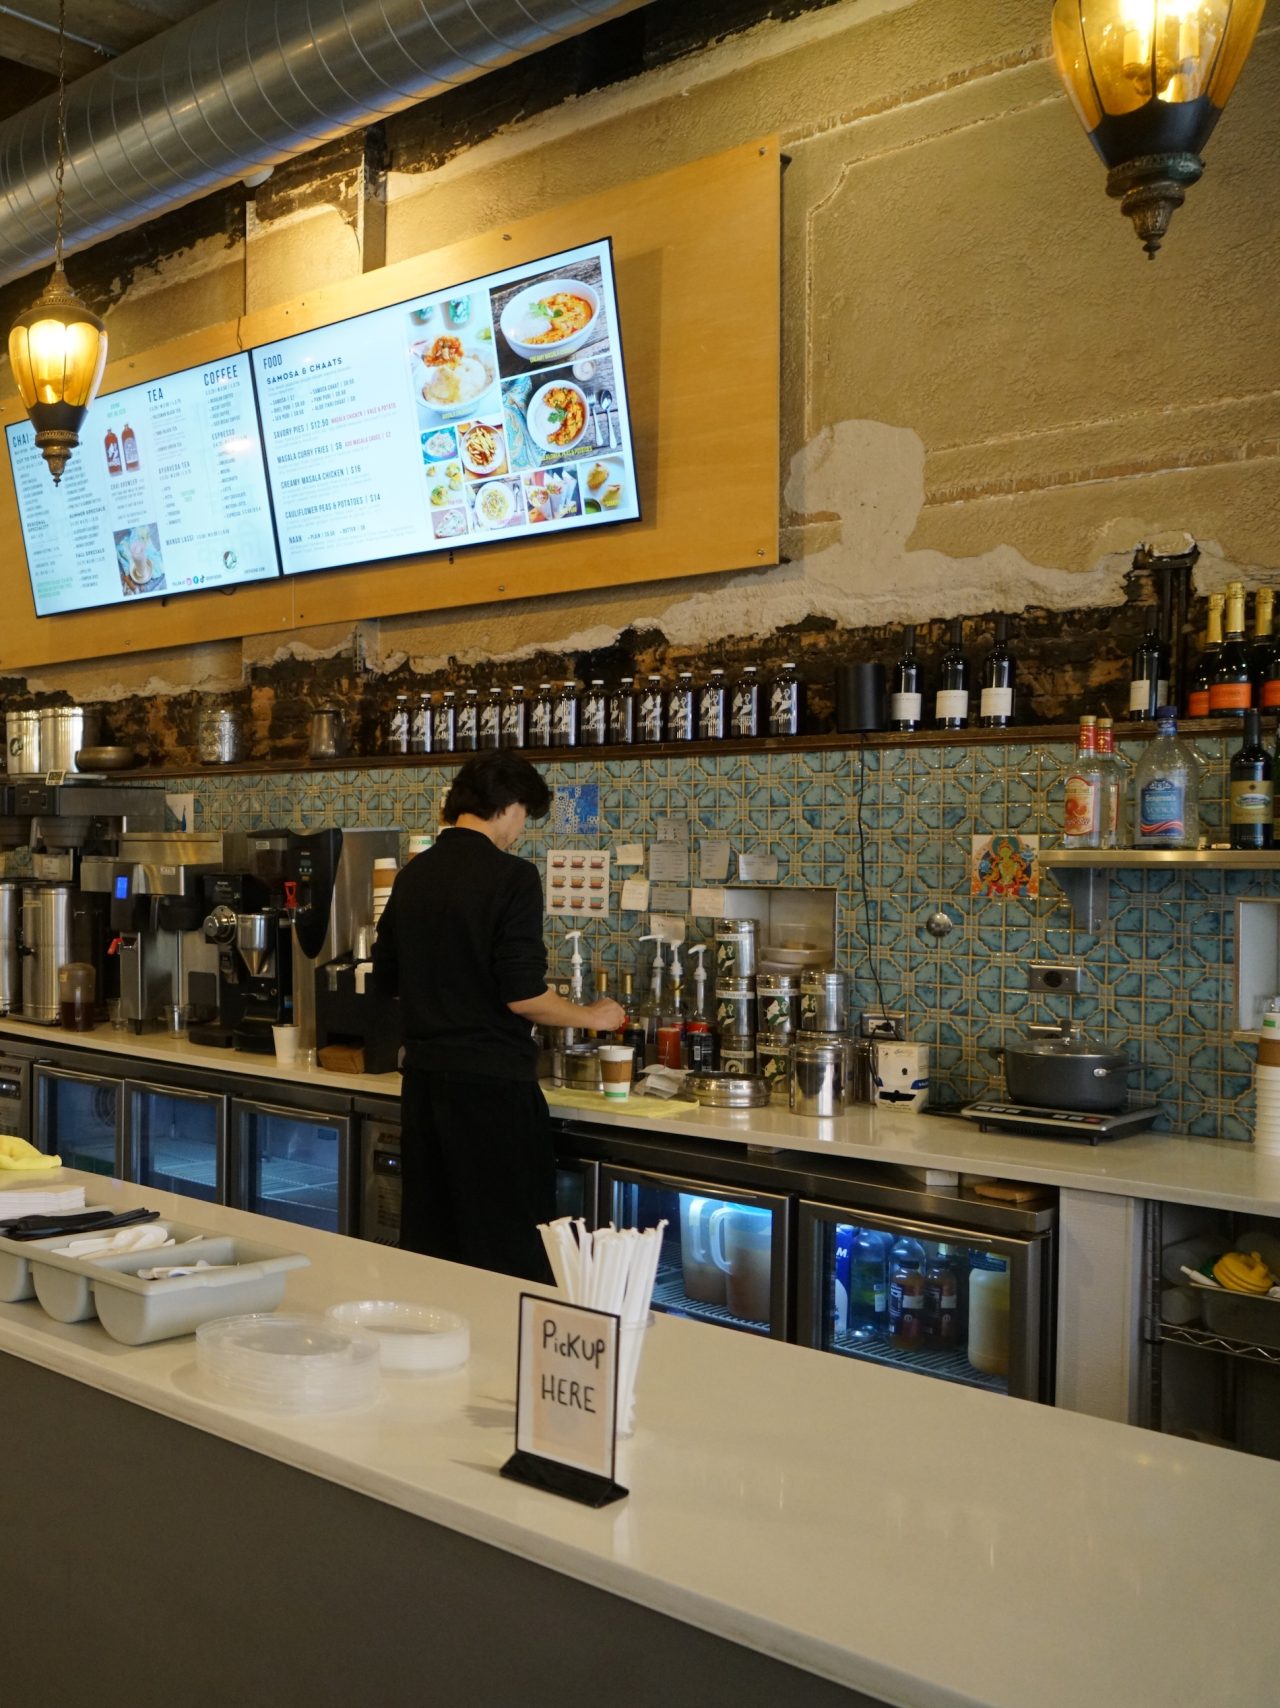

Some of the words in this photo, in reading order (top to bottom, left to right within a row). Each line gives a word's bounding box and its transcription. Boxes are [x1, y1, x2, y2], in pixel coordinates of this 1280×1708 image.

[263, 353, 282, 369] FOOD
[266, 369, 299, 384] SAMOSA
[309, 356, 342, 372] CHAATS
[203, 364, 238, 386] COFFEE
[146, 387, 163, 403] TEA
[211, 428, 235, 440] ESPRESSO
[273, 427, 292, 439] SAVORY
[293, 424, 304, 434] PIES
[310, 417, 328, 429] $12.50
[12, 432, 29, 447] CHAI
[314, 444, 328, 455] FRIES
[280, 477, 300, 488] CREAMY
[301, 473, 321, 484] MASALA
[321, 468, 344, 480] CHICKEN
[284, 505, 318, 519] CAULIFLOWER
[318, 502, 332, 512] PEAS
[337, 496, 363, 508] POTATOES
[288, 534, 302, 544] NAAN
[541, 1374, 596, 1414] HERE
